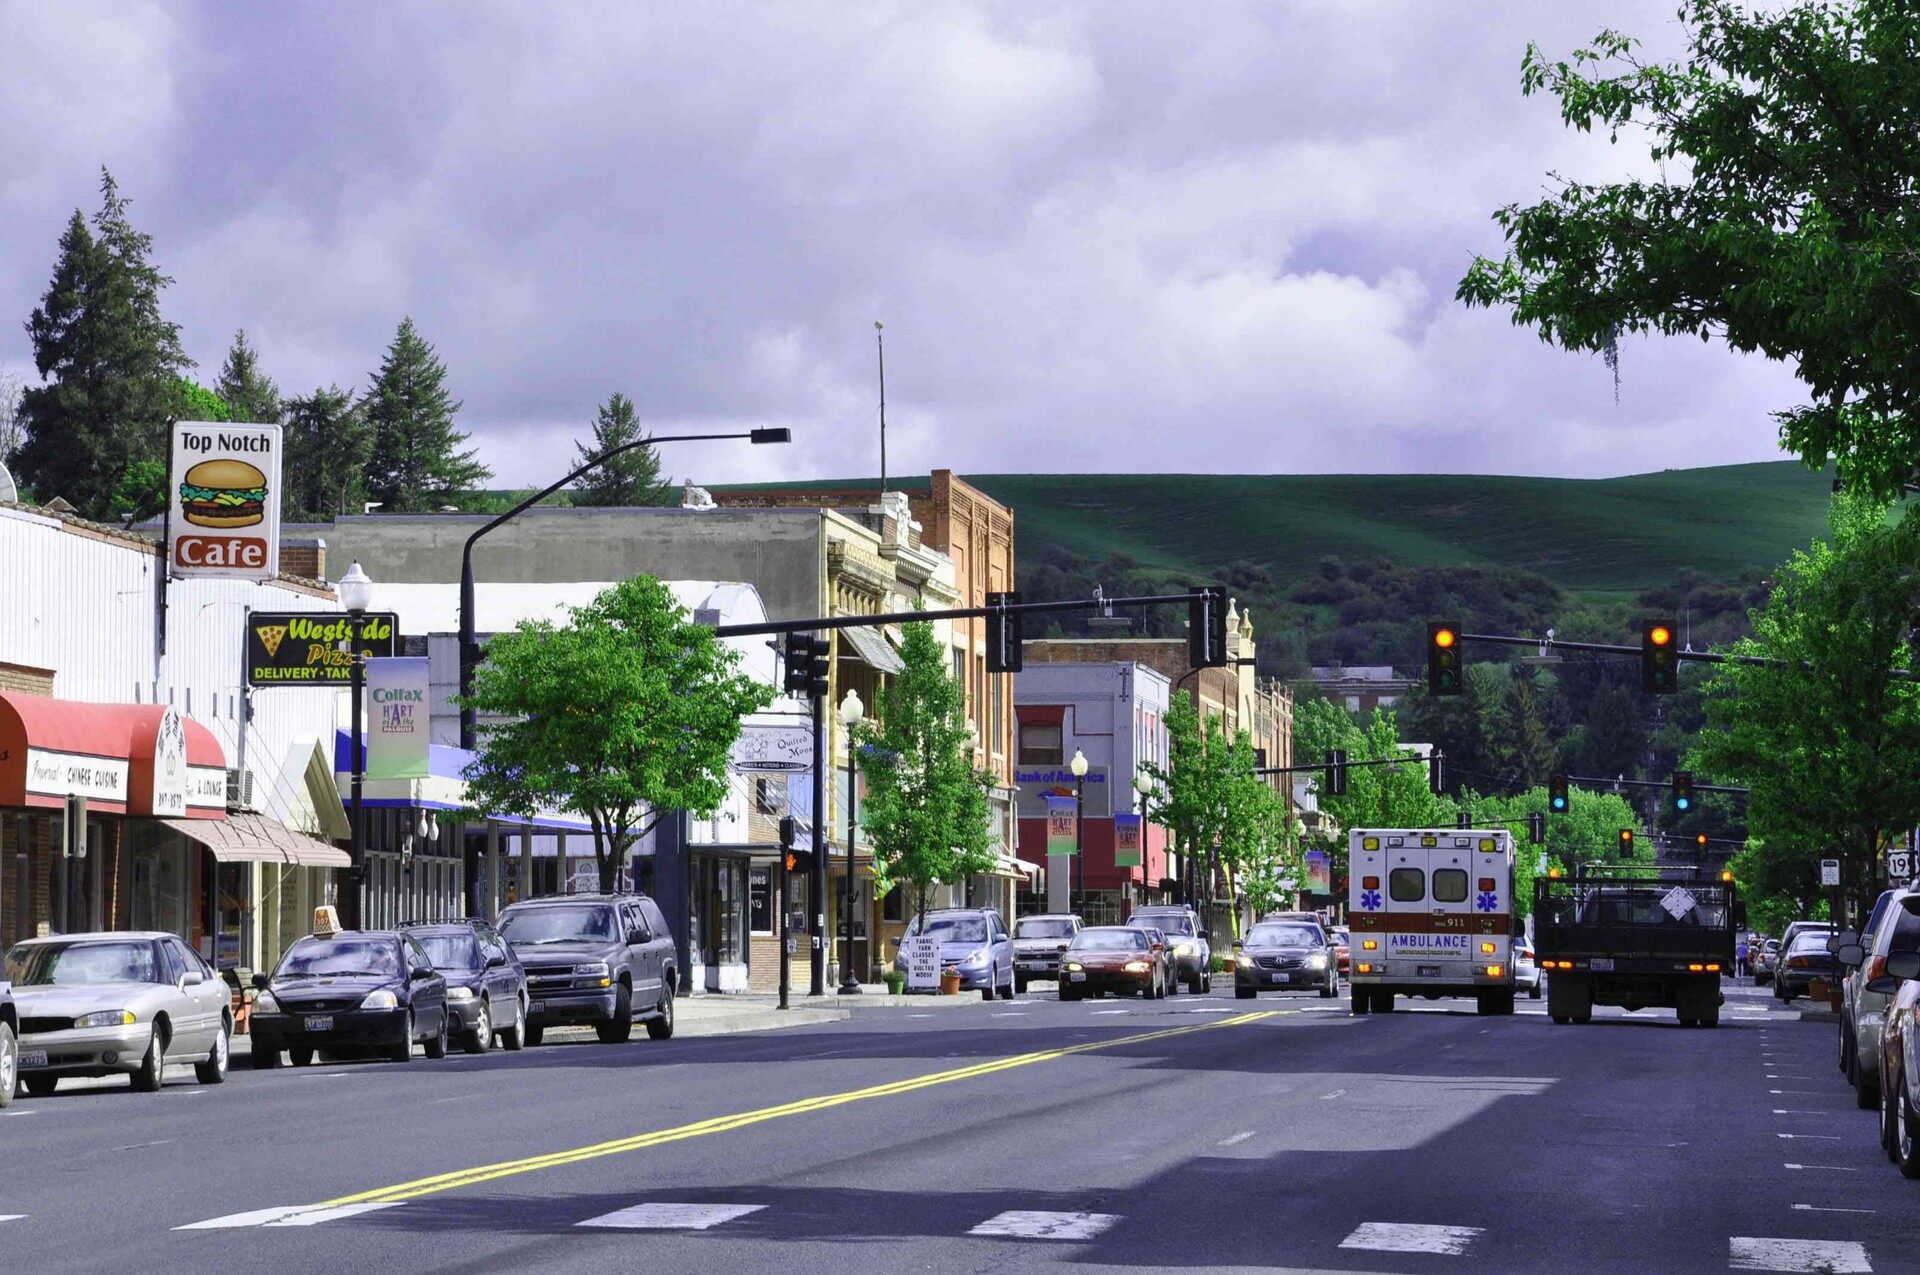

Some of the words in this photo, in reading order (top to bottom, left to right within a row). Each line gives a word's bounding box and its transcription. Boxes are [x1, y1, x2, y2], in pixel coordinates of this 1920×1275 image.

[181, 432, 212, 453] Top
[218, 433, 271, 452] Notch
[180, 538, 262, 565] Cafe
[289, 618, 391, 641] Westsde
[255, 668, 318, 679] DELIVERY
[326, 668, 351, 679] TAK
[372, 688, 423, 702] Colfax
[777, 735, 807, 749] Quilted
[788, 746, 812, 759] Moos
[67, 766, 91, 786] CHINESE
[94, 770, 117, 788] CUISINE
[1043, 770, 1055, 782] of
[203, 779, 222, 796] LOUNGE
[1447, 918, 1464, 926] 911
[1391, 935, 1467, 947] AMBULANCE
